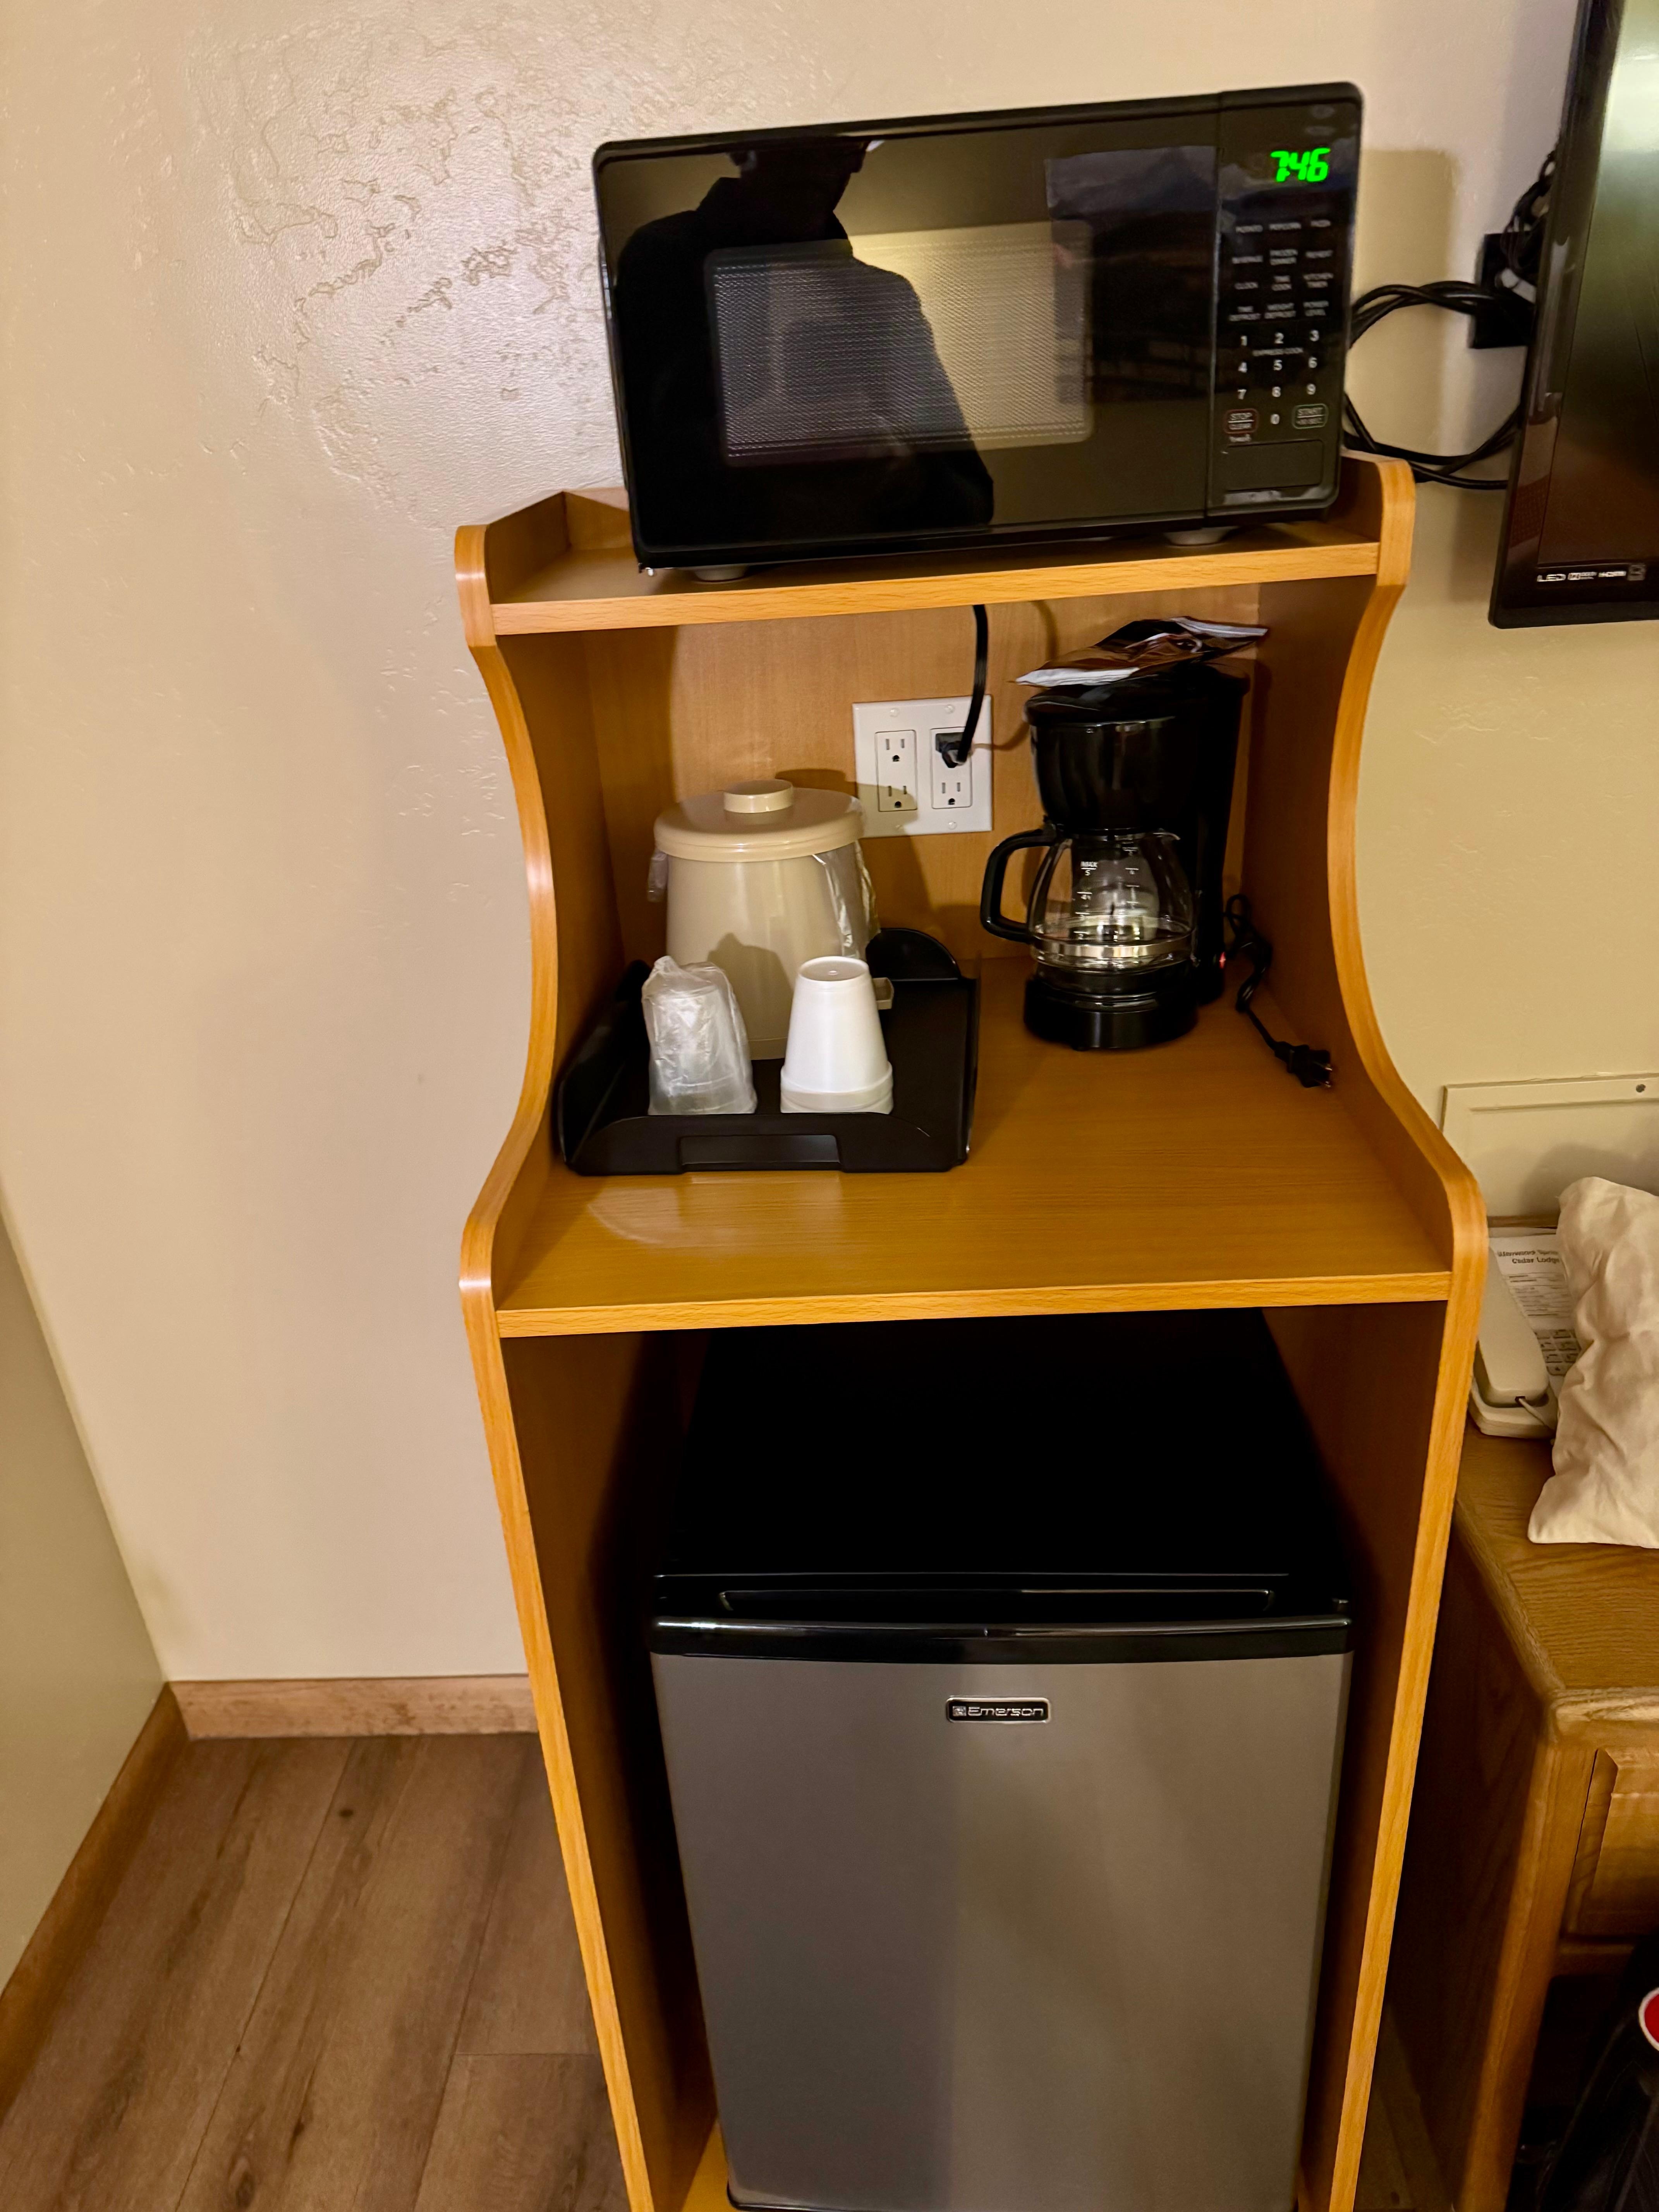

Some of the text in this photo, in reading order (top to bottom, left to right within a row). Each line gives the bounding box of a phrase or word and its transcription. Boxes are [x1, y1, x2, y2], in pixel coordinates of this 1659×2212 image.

[1240, 335, 1247, 346] 1
[1275, 333, 1284, 344] 2
[1309, 330, 1319, 342] 3
[1238, 362, 1247, 373] 4
[1273, 360, 1282, 371] 5
[1308, 357, 1317, 368] 6
[1238, 389, 1247, 400] 7
[1272, 386, 1281, 397] 8
[1306, 383, 1316, 395] 9
[1270, 414, 1280, 424] 0
[1537, 574, 1566, 582] LED
[968, 1707, 1044, 1716] Emerson
